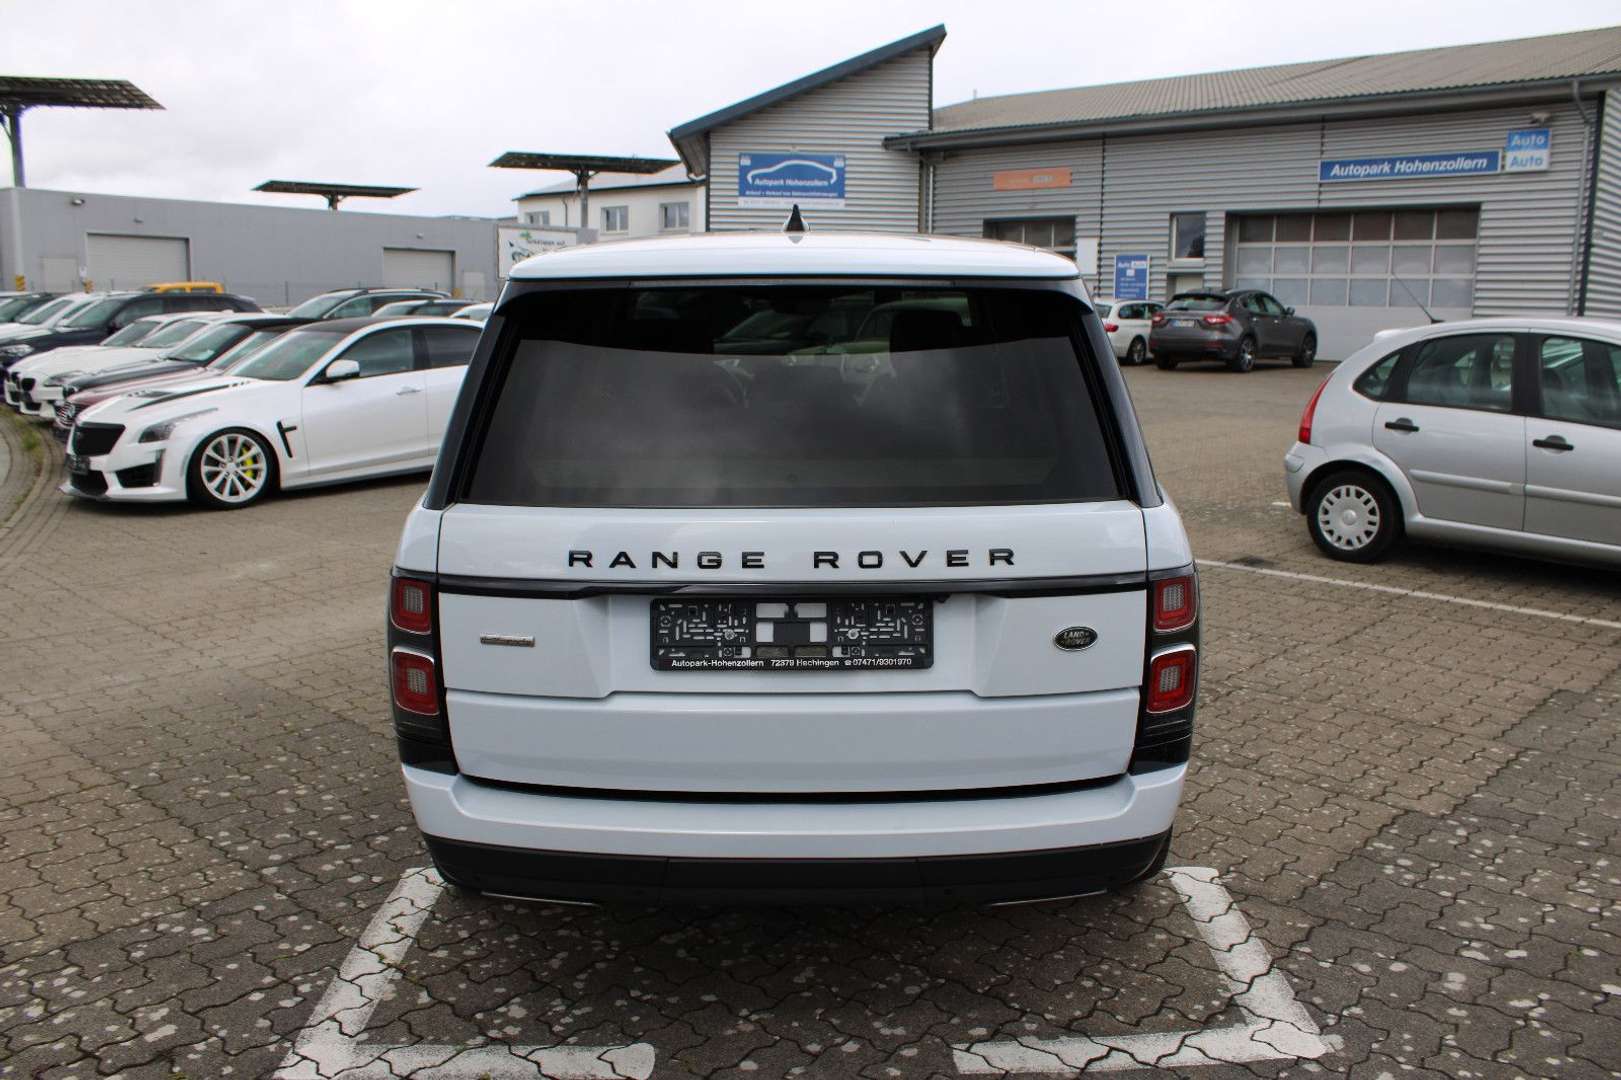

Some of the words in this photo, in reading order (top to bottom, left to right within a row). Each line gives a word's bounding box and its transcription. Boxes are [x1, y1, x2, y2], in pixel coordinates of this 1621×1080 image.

[1511, 133, 1545, 147] Auto
[1330, 160, 1391, 178] Autopark
[1394, 156, 1487, 174] Hohenzollern
[1510, 154, 1543, 168] Auto
[568, 550, 765, 569] RANGE
[813, 548, 1015, 569] ROVER
[672, 659, 765, 668] Autopark-Hohenzollern
[770, 659, 795, 667] 72379
[796, 659, 840, 668] Hechingen
